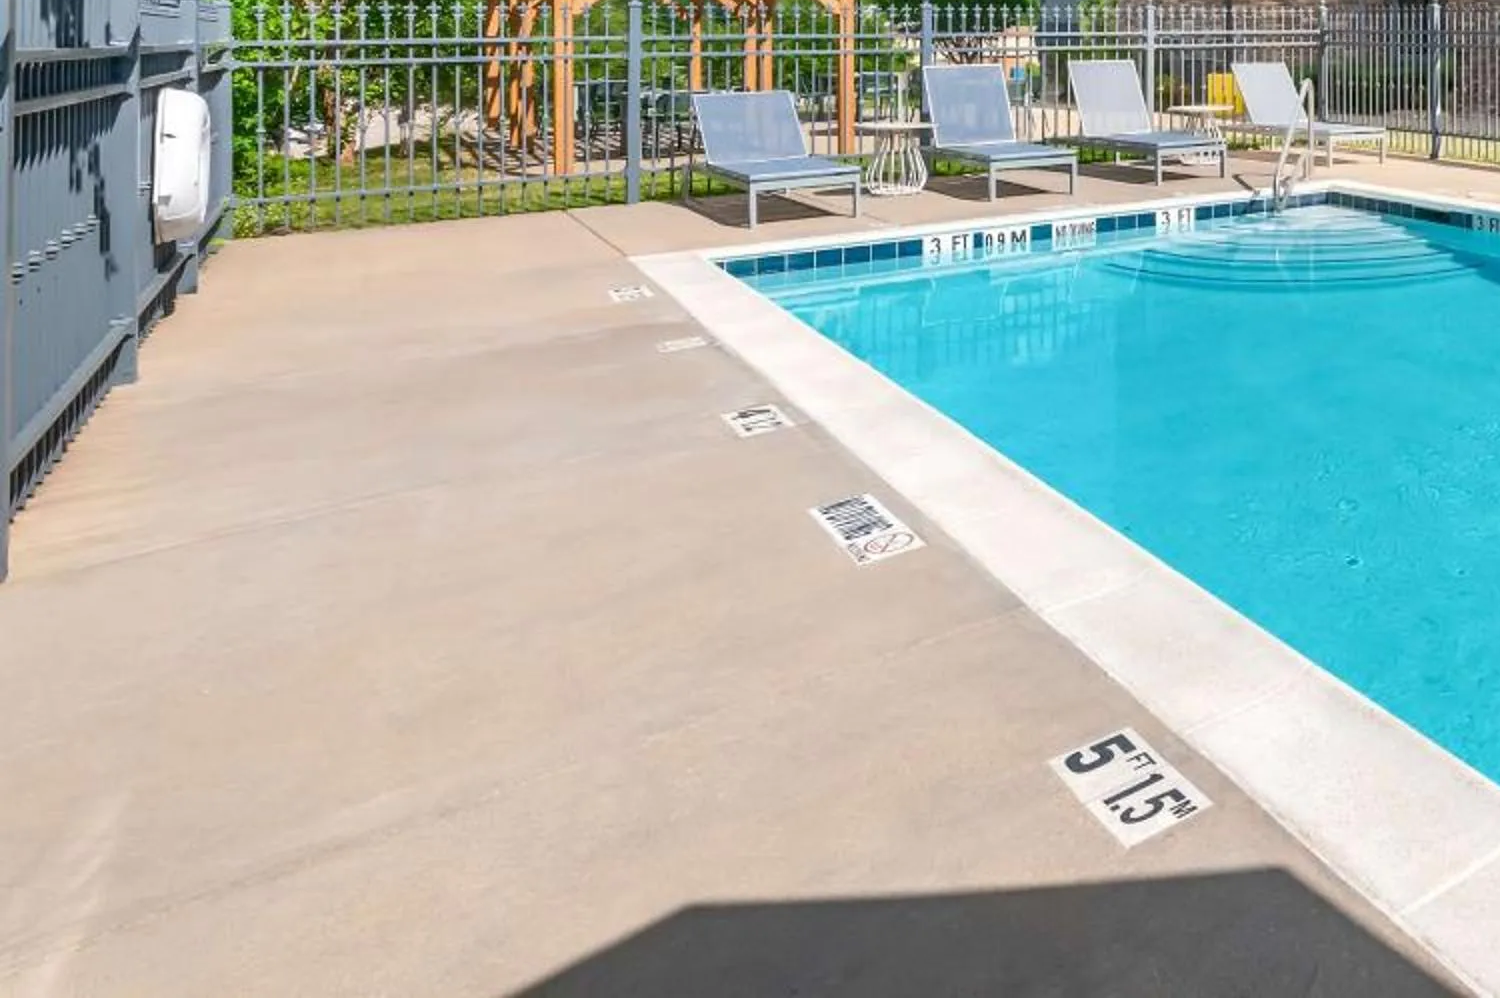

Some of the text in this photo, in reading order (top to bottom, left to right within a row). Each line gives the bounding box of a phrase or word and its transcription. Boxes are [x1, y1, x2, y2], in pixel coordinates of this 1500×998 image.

[929, 237, 941, 253] 3
[952, 234, 969, 250] FT
[1064, 733, 1137, 774] 5
[1125, 751, 1157, 771] FT
